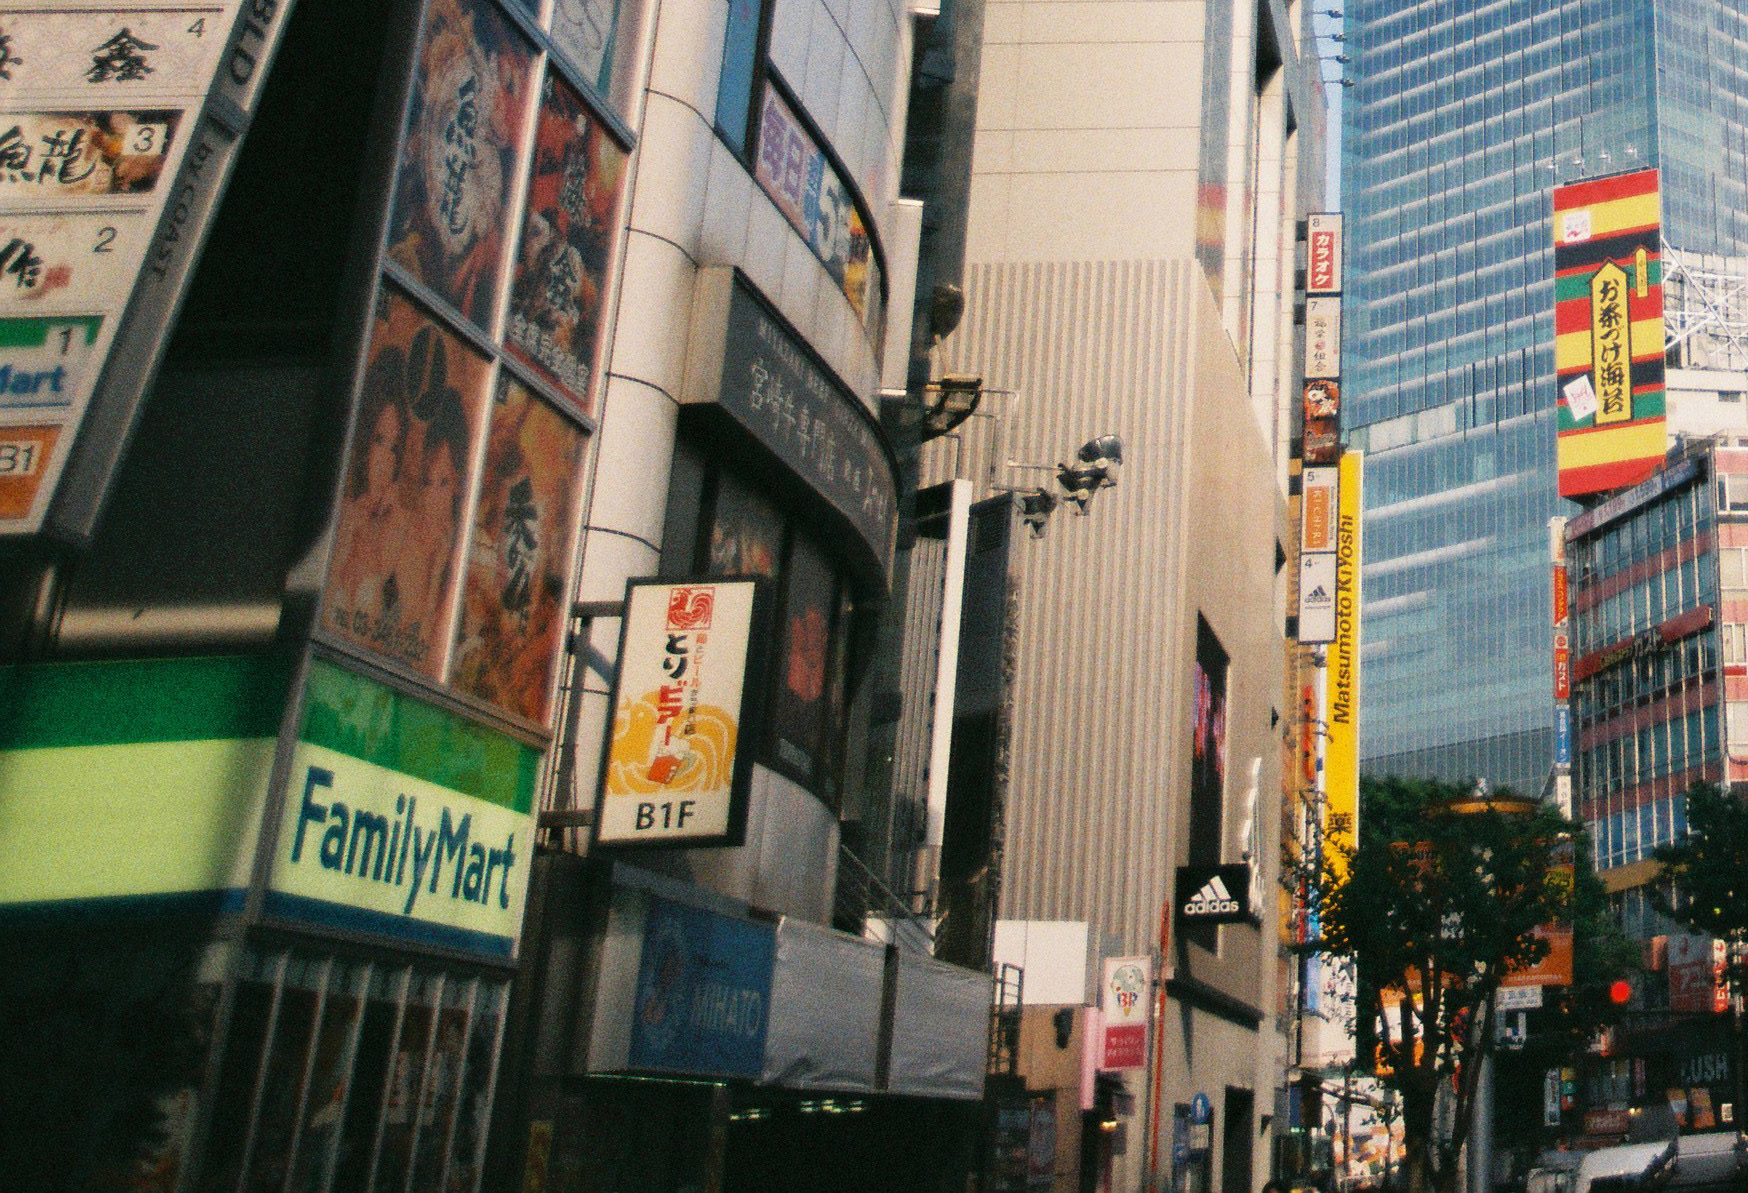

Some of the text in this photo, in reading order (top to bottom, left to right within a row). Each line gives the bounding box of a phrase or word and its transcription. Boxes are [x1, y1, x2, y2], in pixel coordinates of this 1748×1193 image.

[186, 16, 206, 39] 4
[132, 127, 156, 153] 3
[92, 226, 117, 254] 2
[1314, 233, 1331, 287] カラオケ
[1311, 301, 1319, 311] 7
[60, 328, 73, 355] 1
[1598, 278, 1624, 415] お茶づけ海苔
[1307, 470, 1315, 482] 5
[1305, 558, 1312, 568] 4
[1333, 595, 1352, 725] Matsumoto
[656, 633, 689, 746] とりビアー
[633, 800, 697, 831] B1F
[291, 765, 516, 915] FamilyMart
[1184, 896, 1240, 914] adidas
